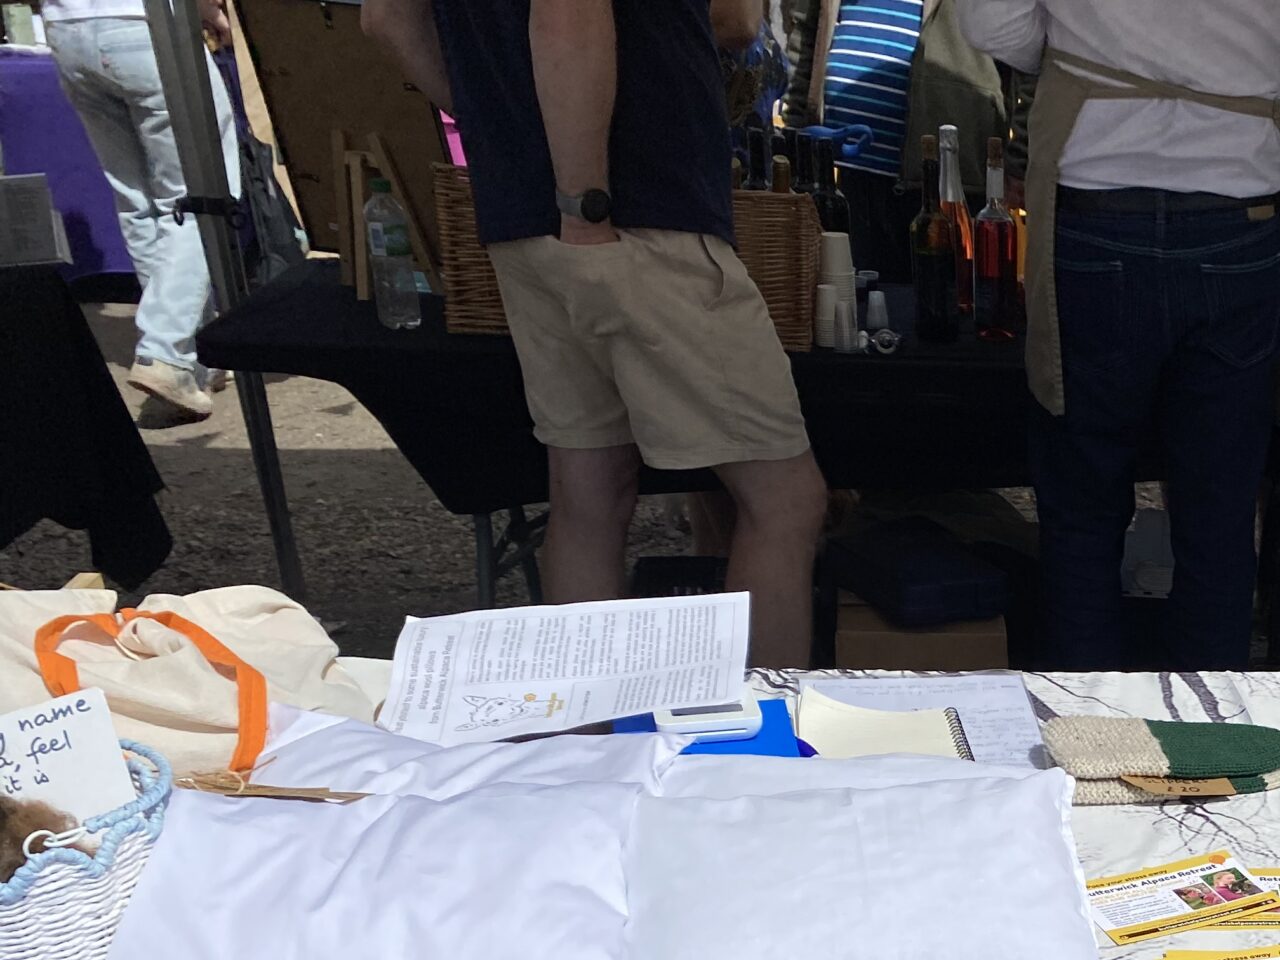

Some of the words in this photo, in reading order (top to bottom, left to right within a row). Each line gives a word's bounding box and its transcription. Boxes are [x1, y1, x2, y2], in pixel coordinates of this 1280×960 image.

[18, 699, 91, 732] name
[26, 729, 72, 765] feel
[3, 775, 22, 794] it
[33, 769, 50, 785] is
[1088, 882, 1138, 898] utterwick
[1141, 874, 1177, 887] Alpaca
[1177, 864, 1217, 877] Retreat
[1148, 869, 1168, 877] away
[1249, 952, 1271, 960] away
